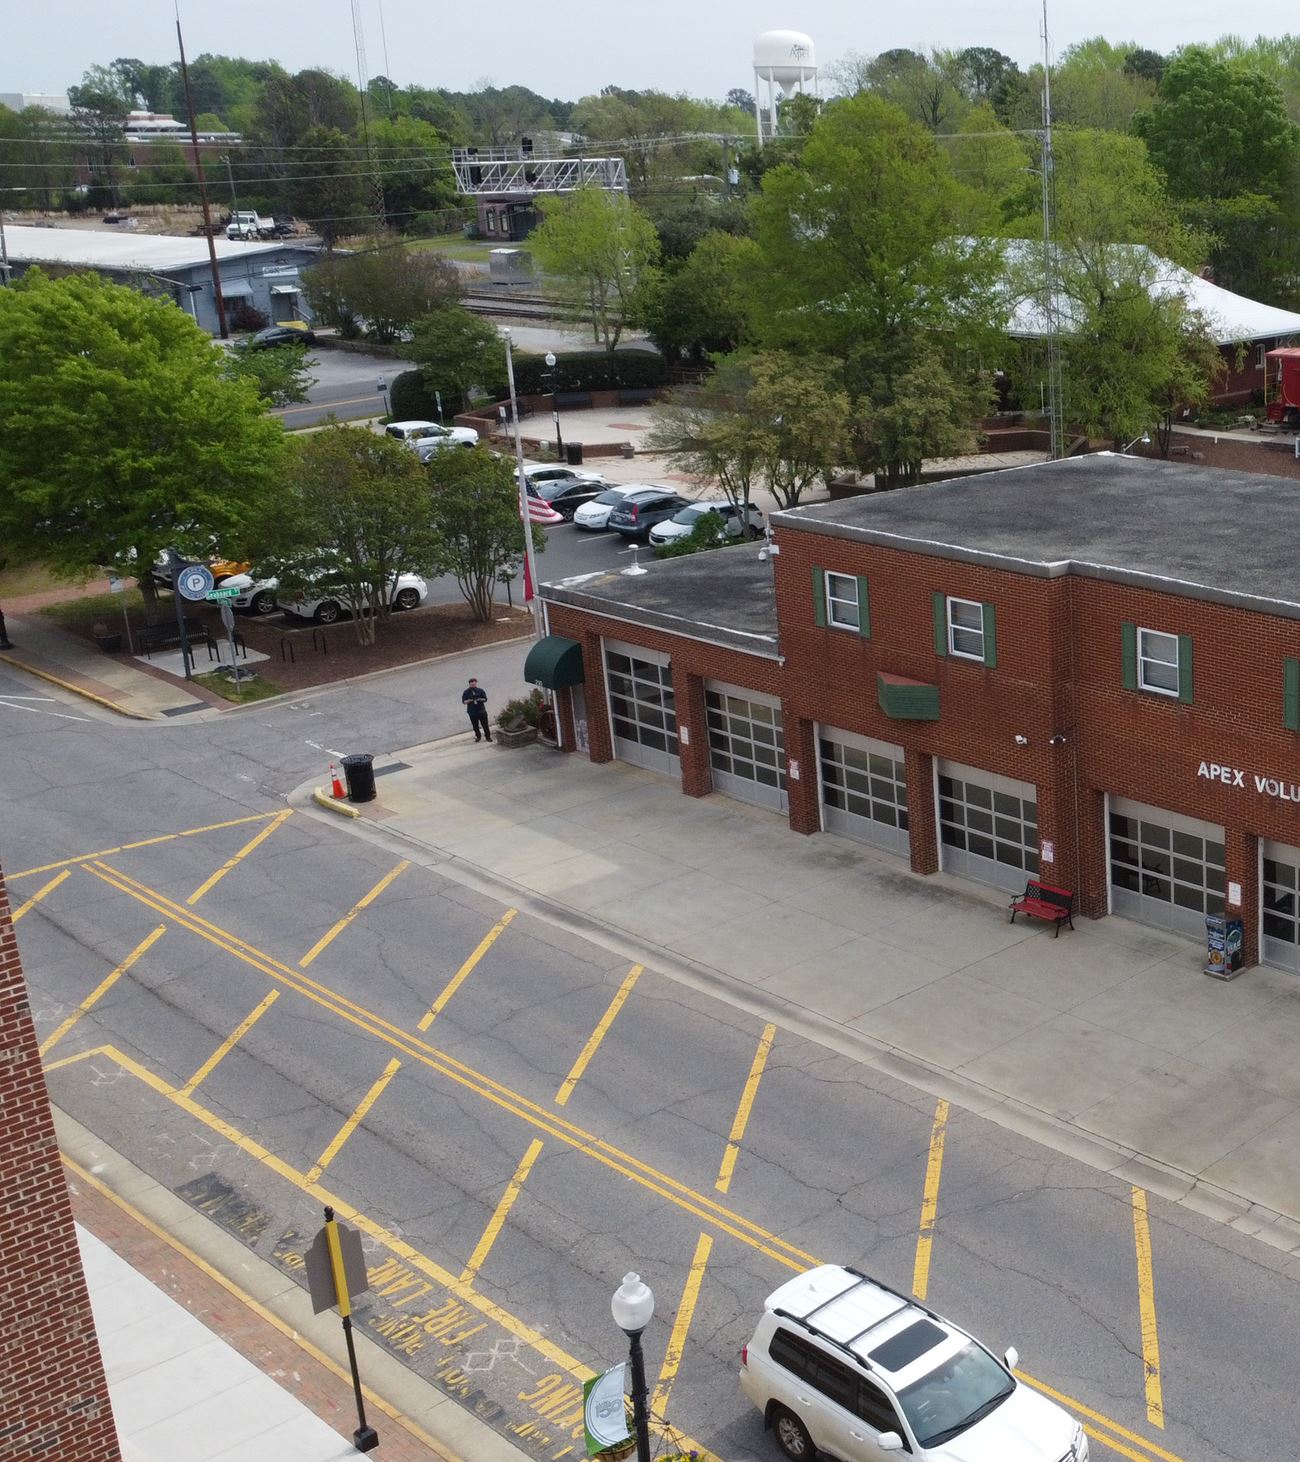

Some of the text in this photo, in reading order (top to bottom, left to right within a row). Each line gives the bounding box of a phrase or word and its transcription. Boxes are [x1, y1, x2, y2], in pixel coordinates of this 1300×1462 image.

[193, 578, 200, 588] P
[1197, 761, 1244, 788] APEX
[366, 1257, 434, 1308] LANE
[411, 1298, 488, 1346] FIRE
